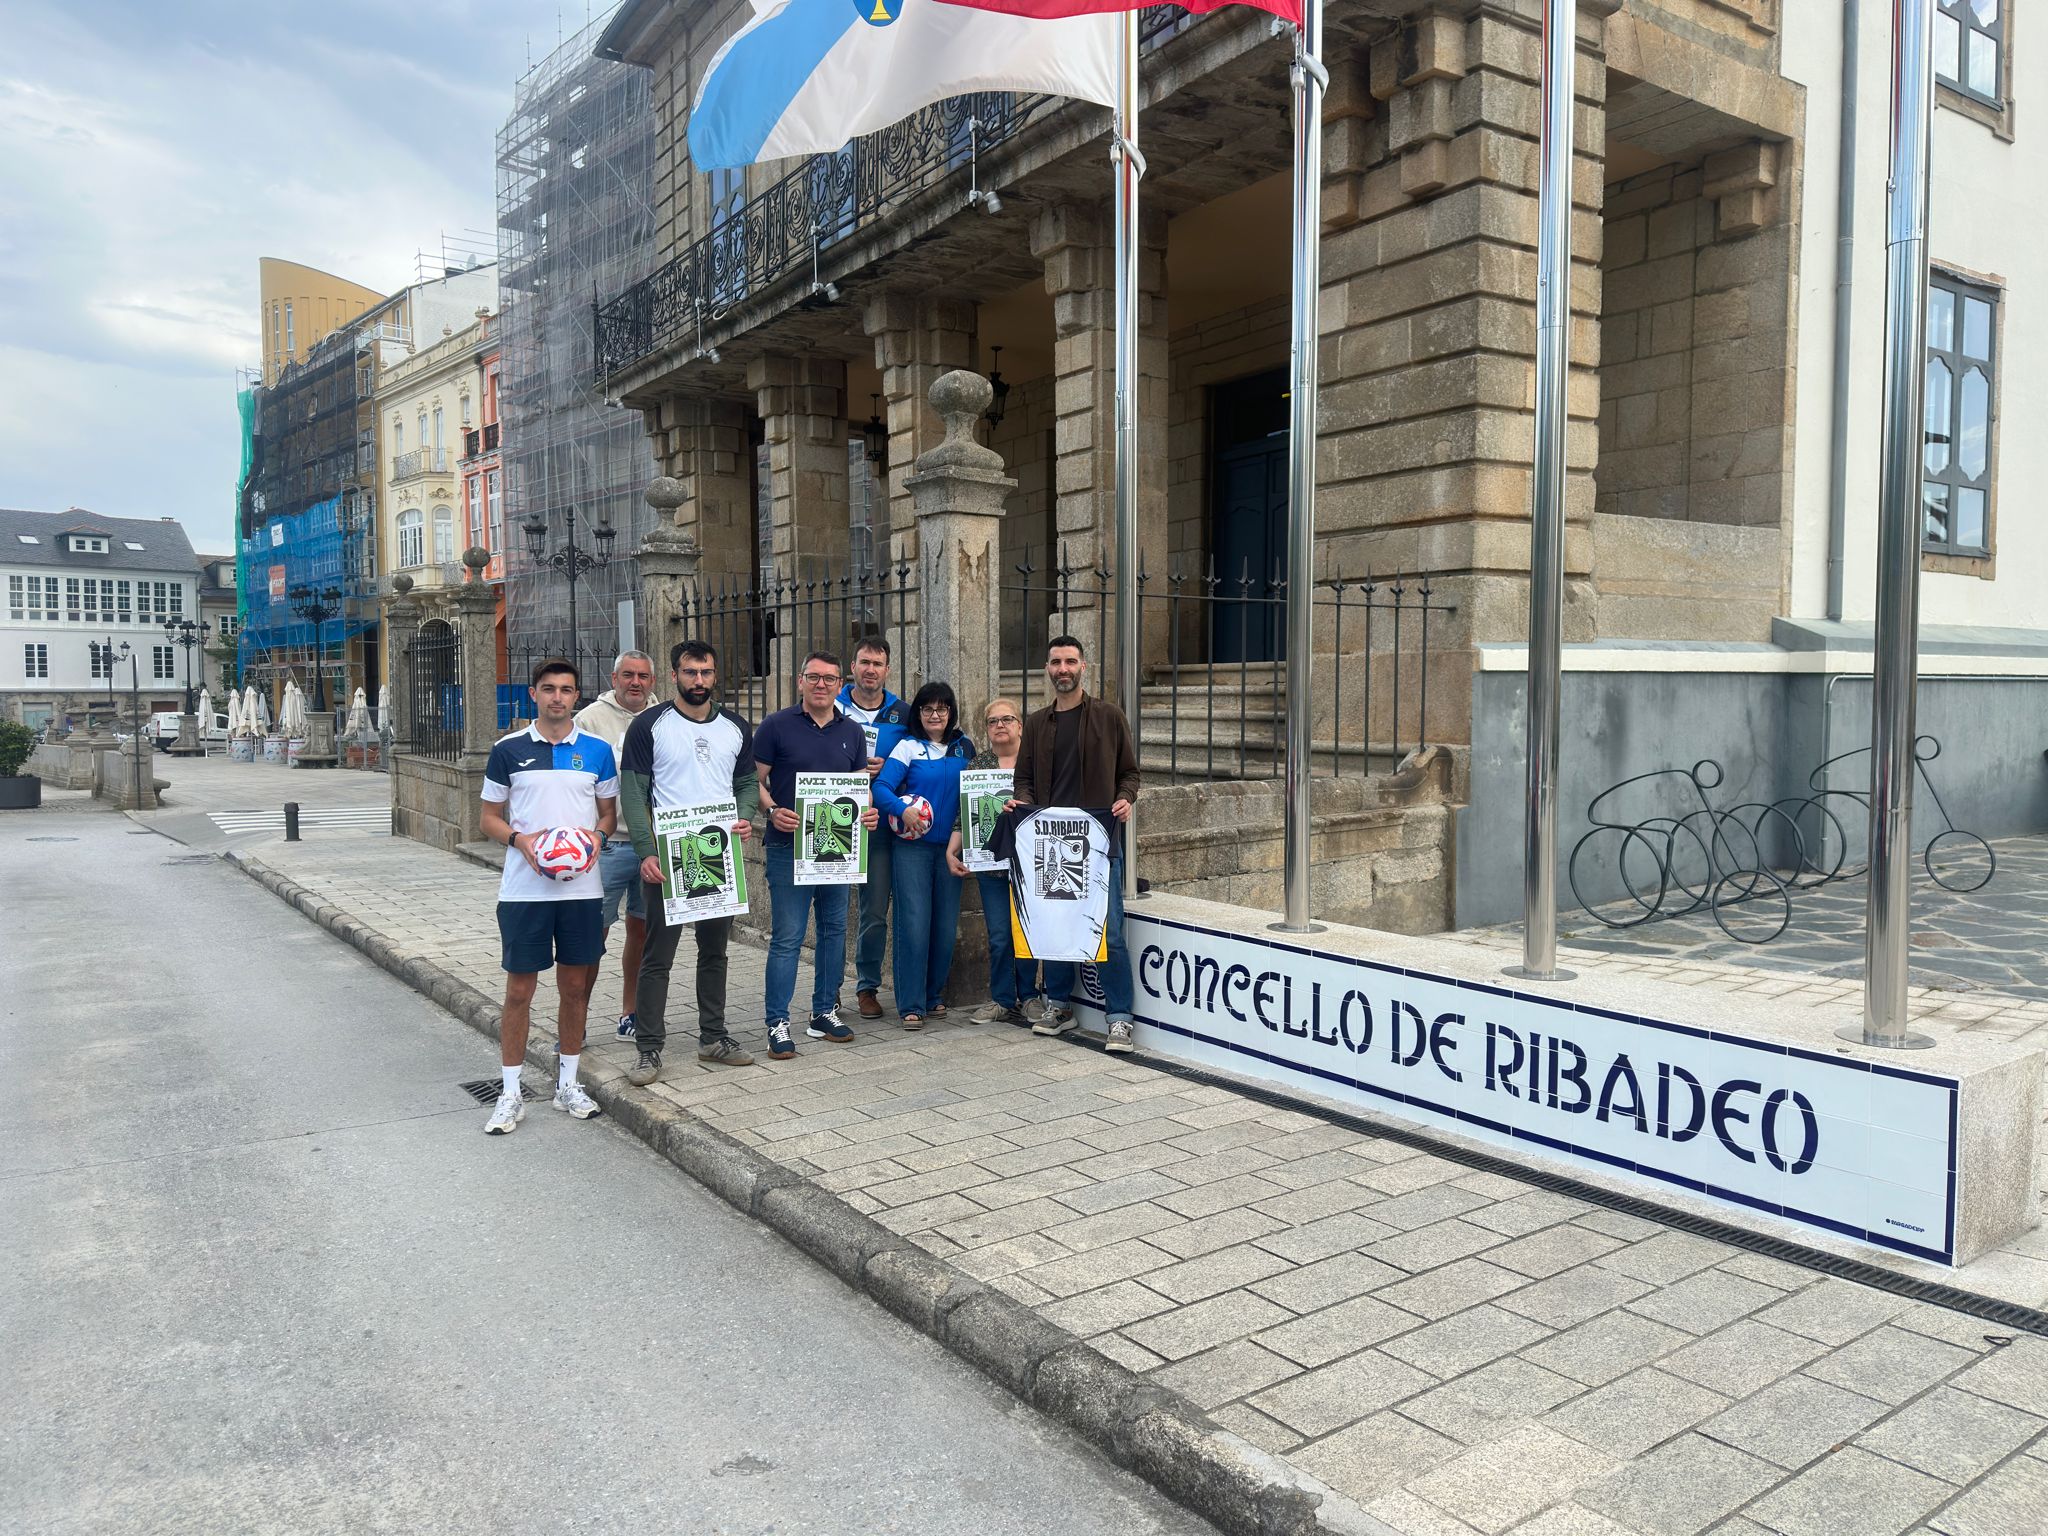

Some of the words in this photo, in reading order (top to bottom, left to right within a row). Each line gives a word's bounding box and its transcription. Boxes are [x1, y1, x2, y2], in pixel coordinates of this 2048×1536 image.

[798, 777, 827, 785] XVII
[830, 777, 868, 786] TORNEO
[657, 809, 688, 820] XVII
[692, 802, 736, 816] TORNEO
[659, 818, 708, 831] INFANTIL
[1139, 944, 1373, 1055] CONCELLO
[1391, 1000, 1466, 1083] DE
[1485, 1022, 1819, 1175] RIBADEO
